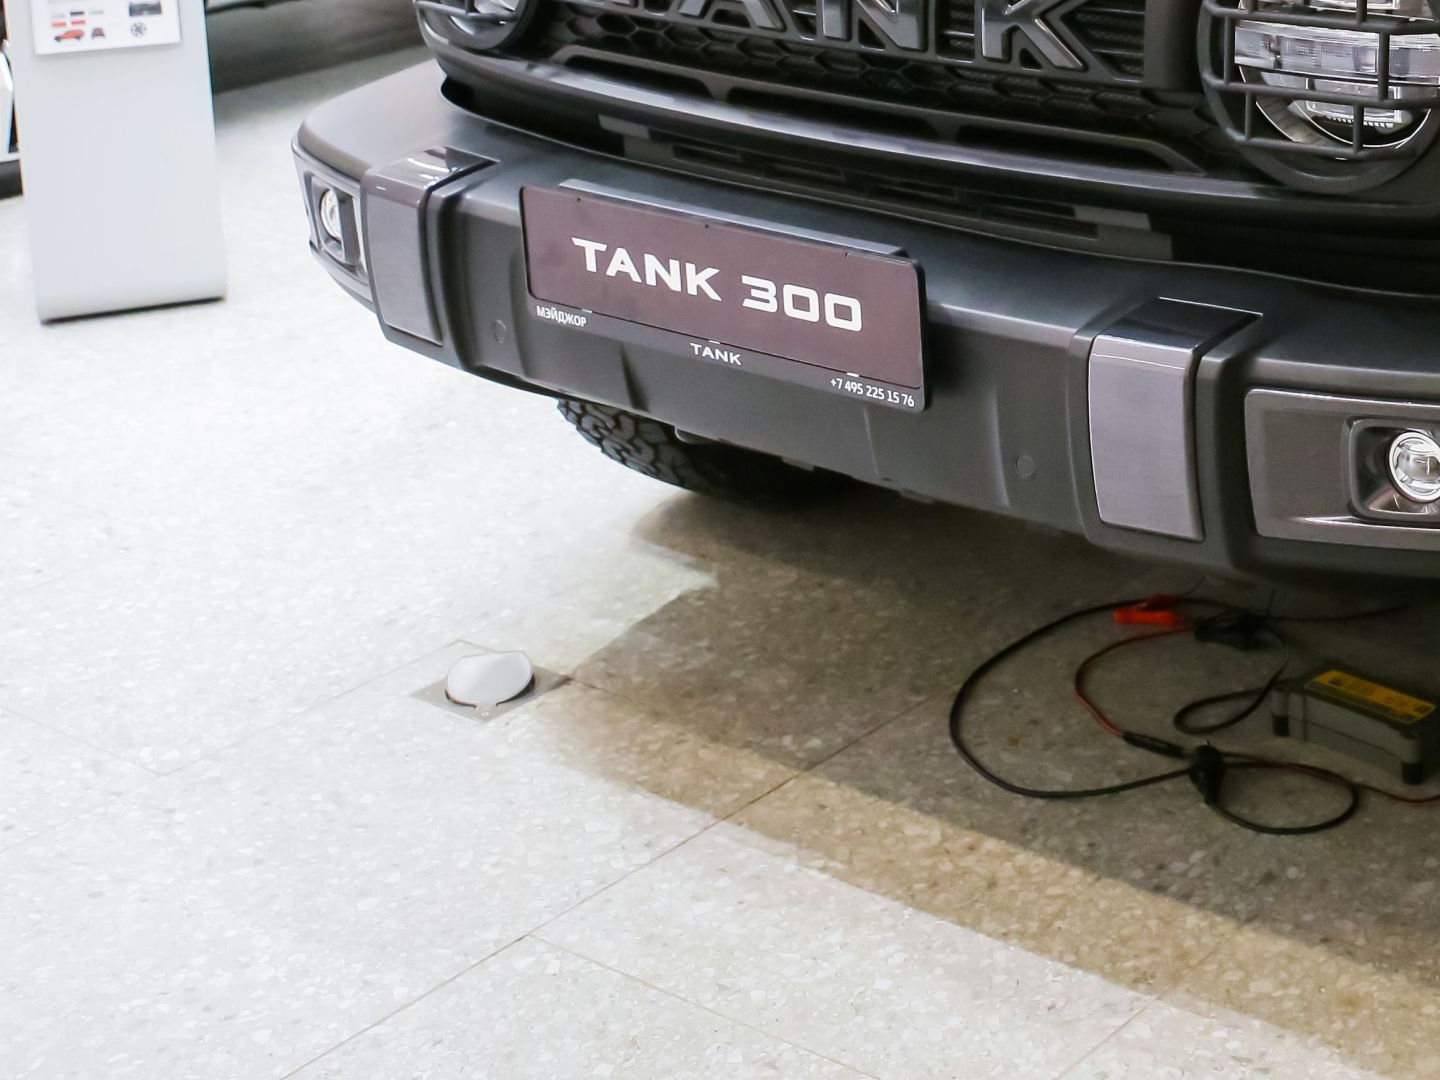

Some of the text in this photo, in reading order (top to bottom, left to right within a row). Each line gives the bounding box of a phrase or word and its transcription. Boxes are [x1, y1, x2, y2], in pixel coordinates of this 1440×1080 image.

[572, 237, 862, 332] TANK 300
[536, 305, 587, 327] МЭЙДЖОР
[690, 342, 742, 366] TANK
[830, 378, 915, 407] +7 495 225 15 76
